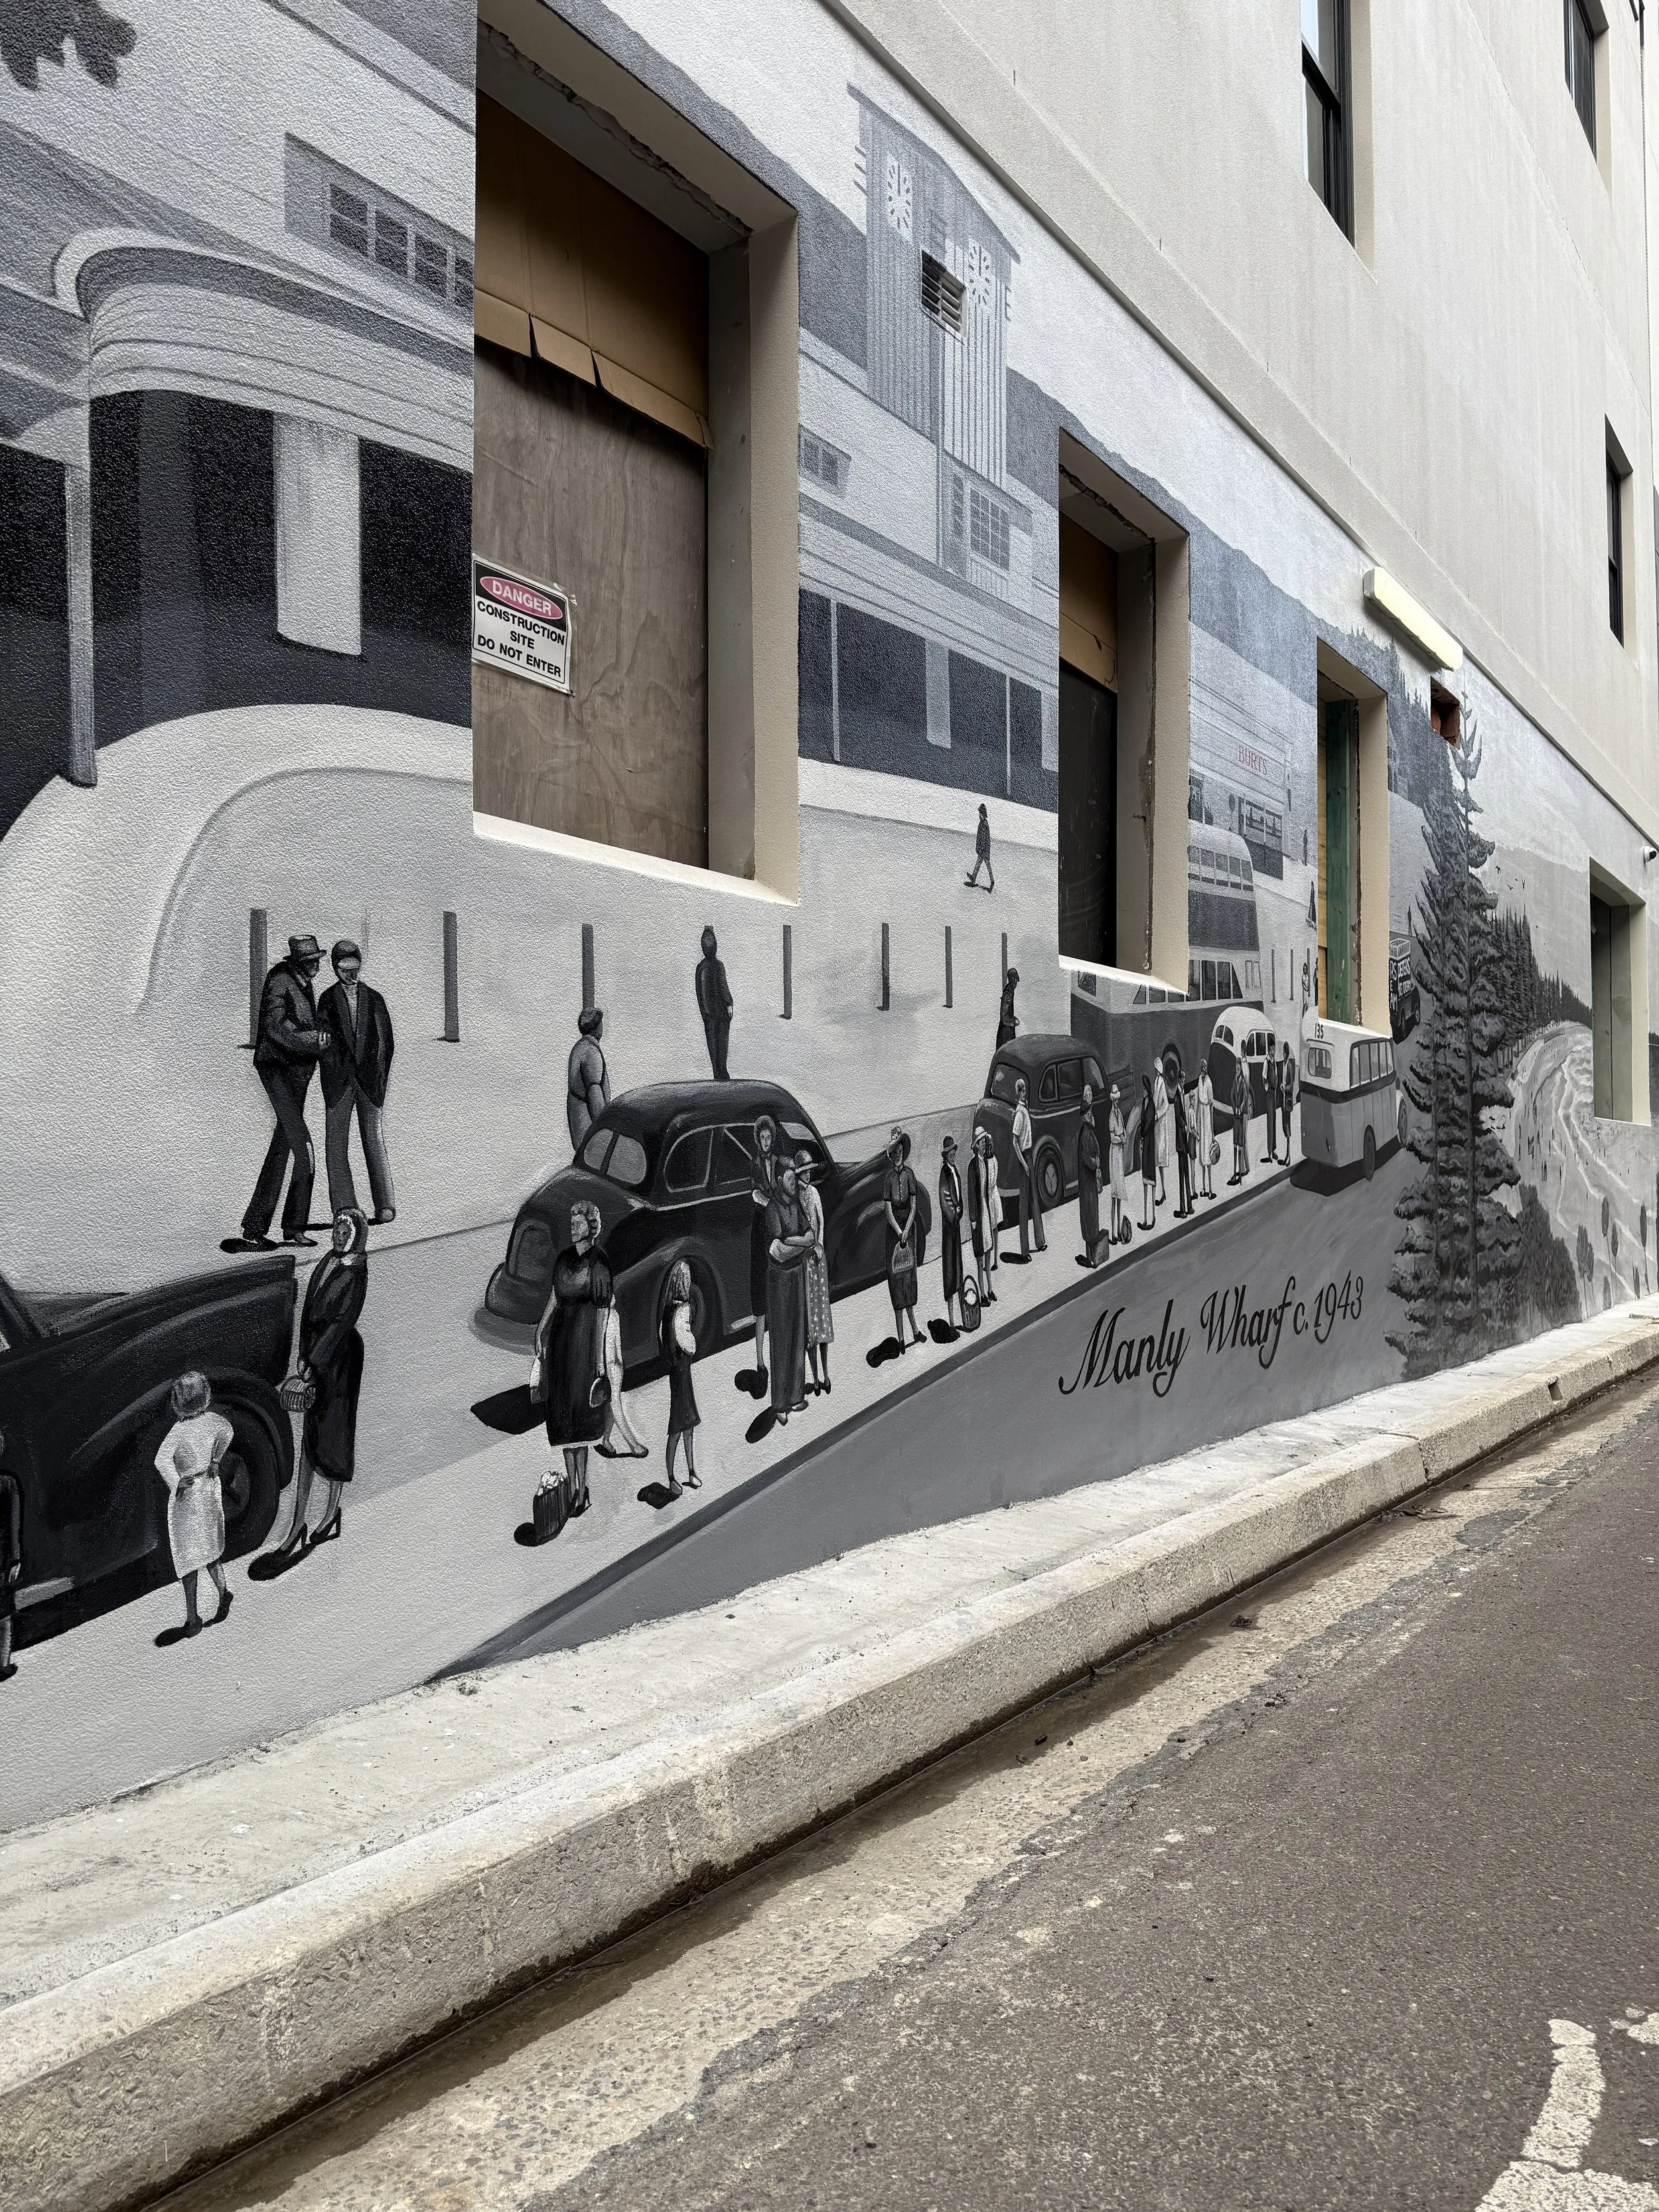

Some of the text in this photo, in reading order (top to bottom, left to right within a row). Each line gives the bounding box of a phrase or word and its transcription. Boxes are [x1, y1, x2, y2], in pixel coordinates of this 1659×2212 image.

[492, 579, 551, 616] DANGER
[476, 601, 565, 646] CONSTRUCTION
[510, 630, 535, 650] SITE
[477, 634, 561, 678] DO NOT ENTER
[1238, 745, 1267, 775] BURTS
[1315, 1023, 1324, 1039] 135
[1058, 1298, 1190, 1398] Manly
[1200, 1276, 1296, 1369] Wharf
